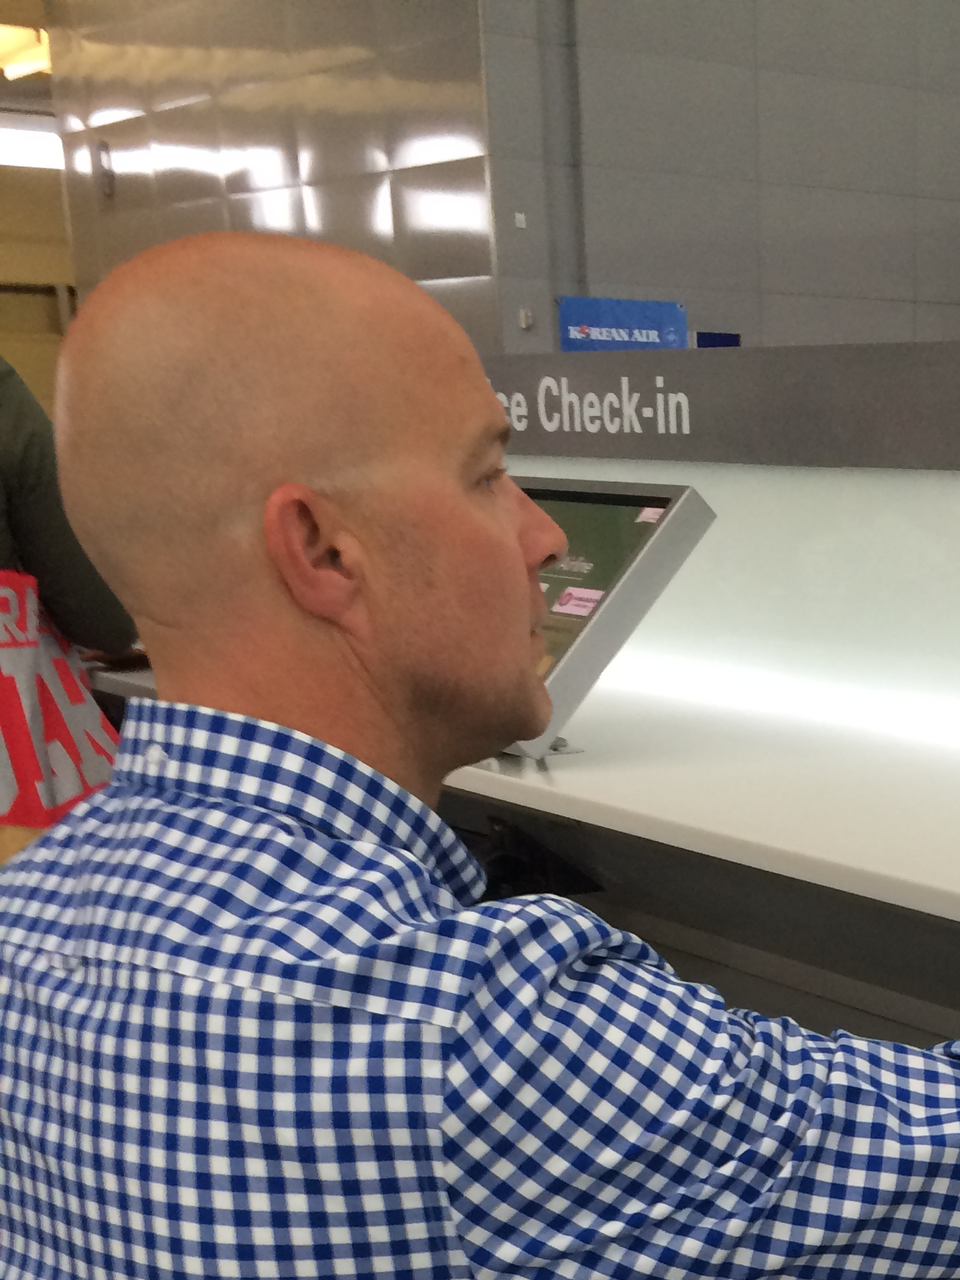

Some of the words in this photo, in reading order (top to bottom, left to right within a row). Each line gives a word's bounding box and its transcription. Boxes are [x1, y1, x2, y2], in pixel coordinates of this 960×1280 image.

[567, 325, 630, 341] KOREAN
[631, 329, 661, 343] AIR
[537, 375, 691, 435] Check-in
